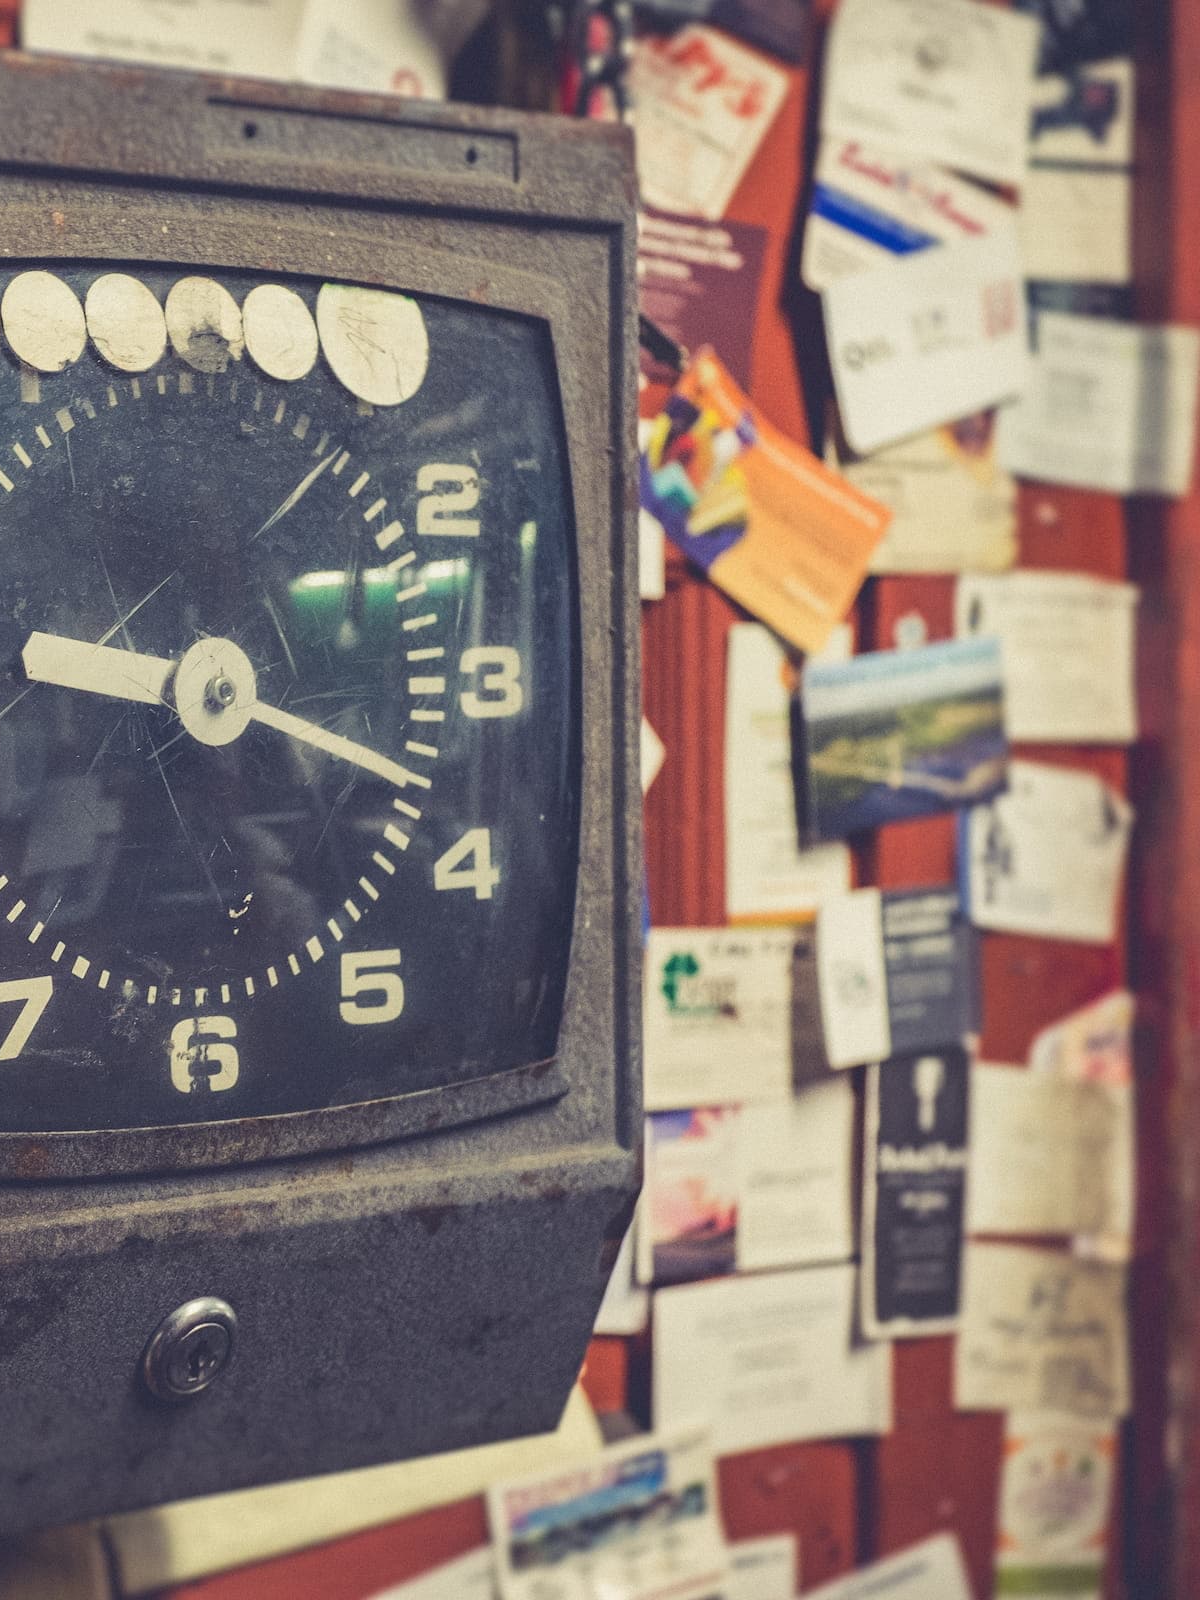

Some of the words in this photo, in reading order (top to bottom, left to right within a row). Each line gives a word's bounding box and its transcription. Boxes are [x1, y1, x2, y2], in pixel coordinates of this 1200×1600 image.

[415, 463, 480, 536] 2
[460, 644, 524, 719] 3
[434, 828, 500, 899] 4
[340, 949, 404, 1024] 5
[171, 1016, 238, 1092] 6
